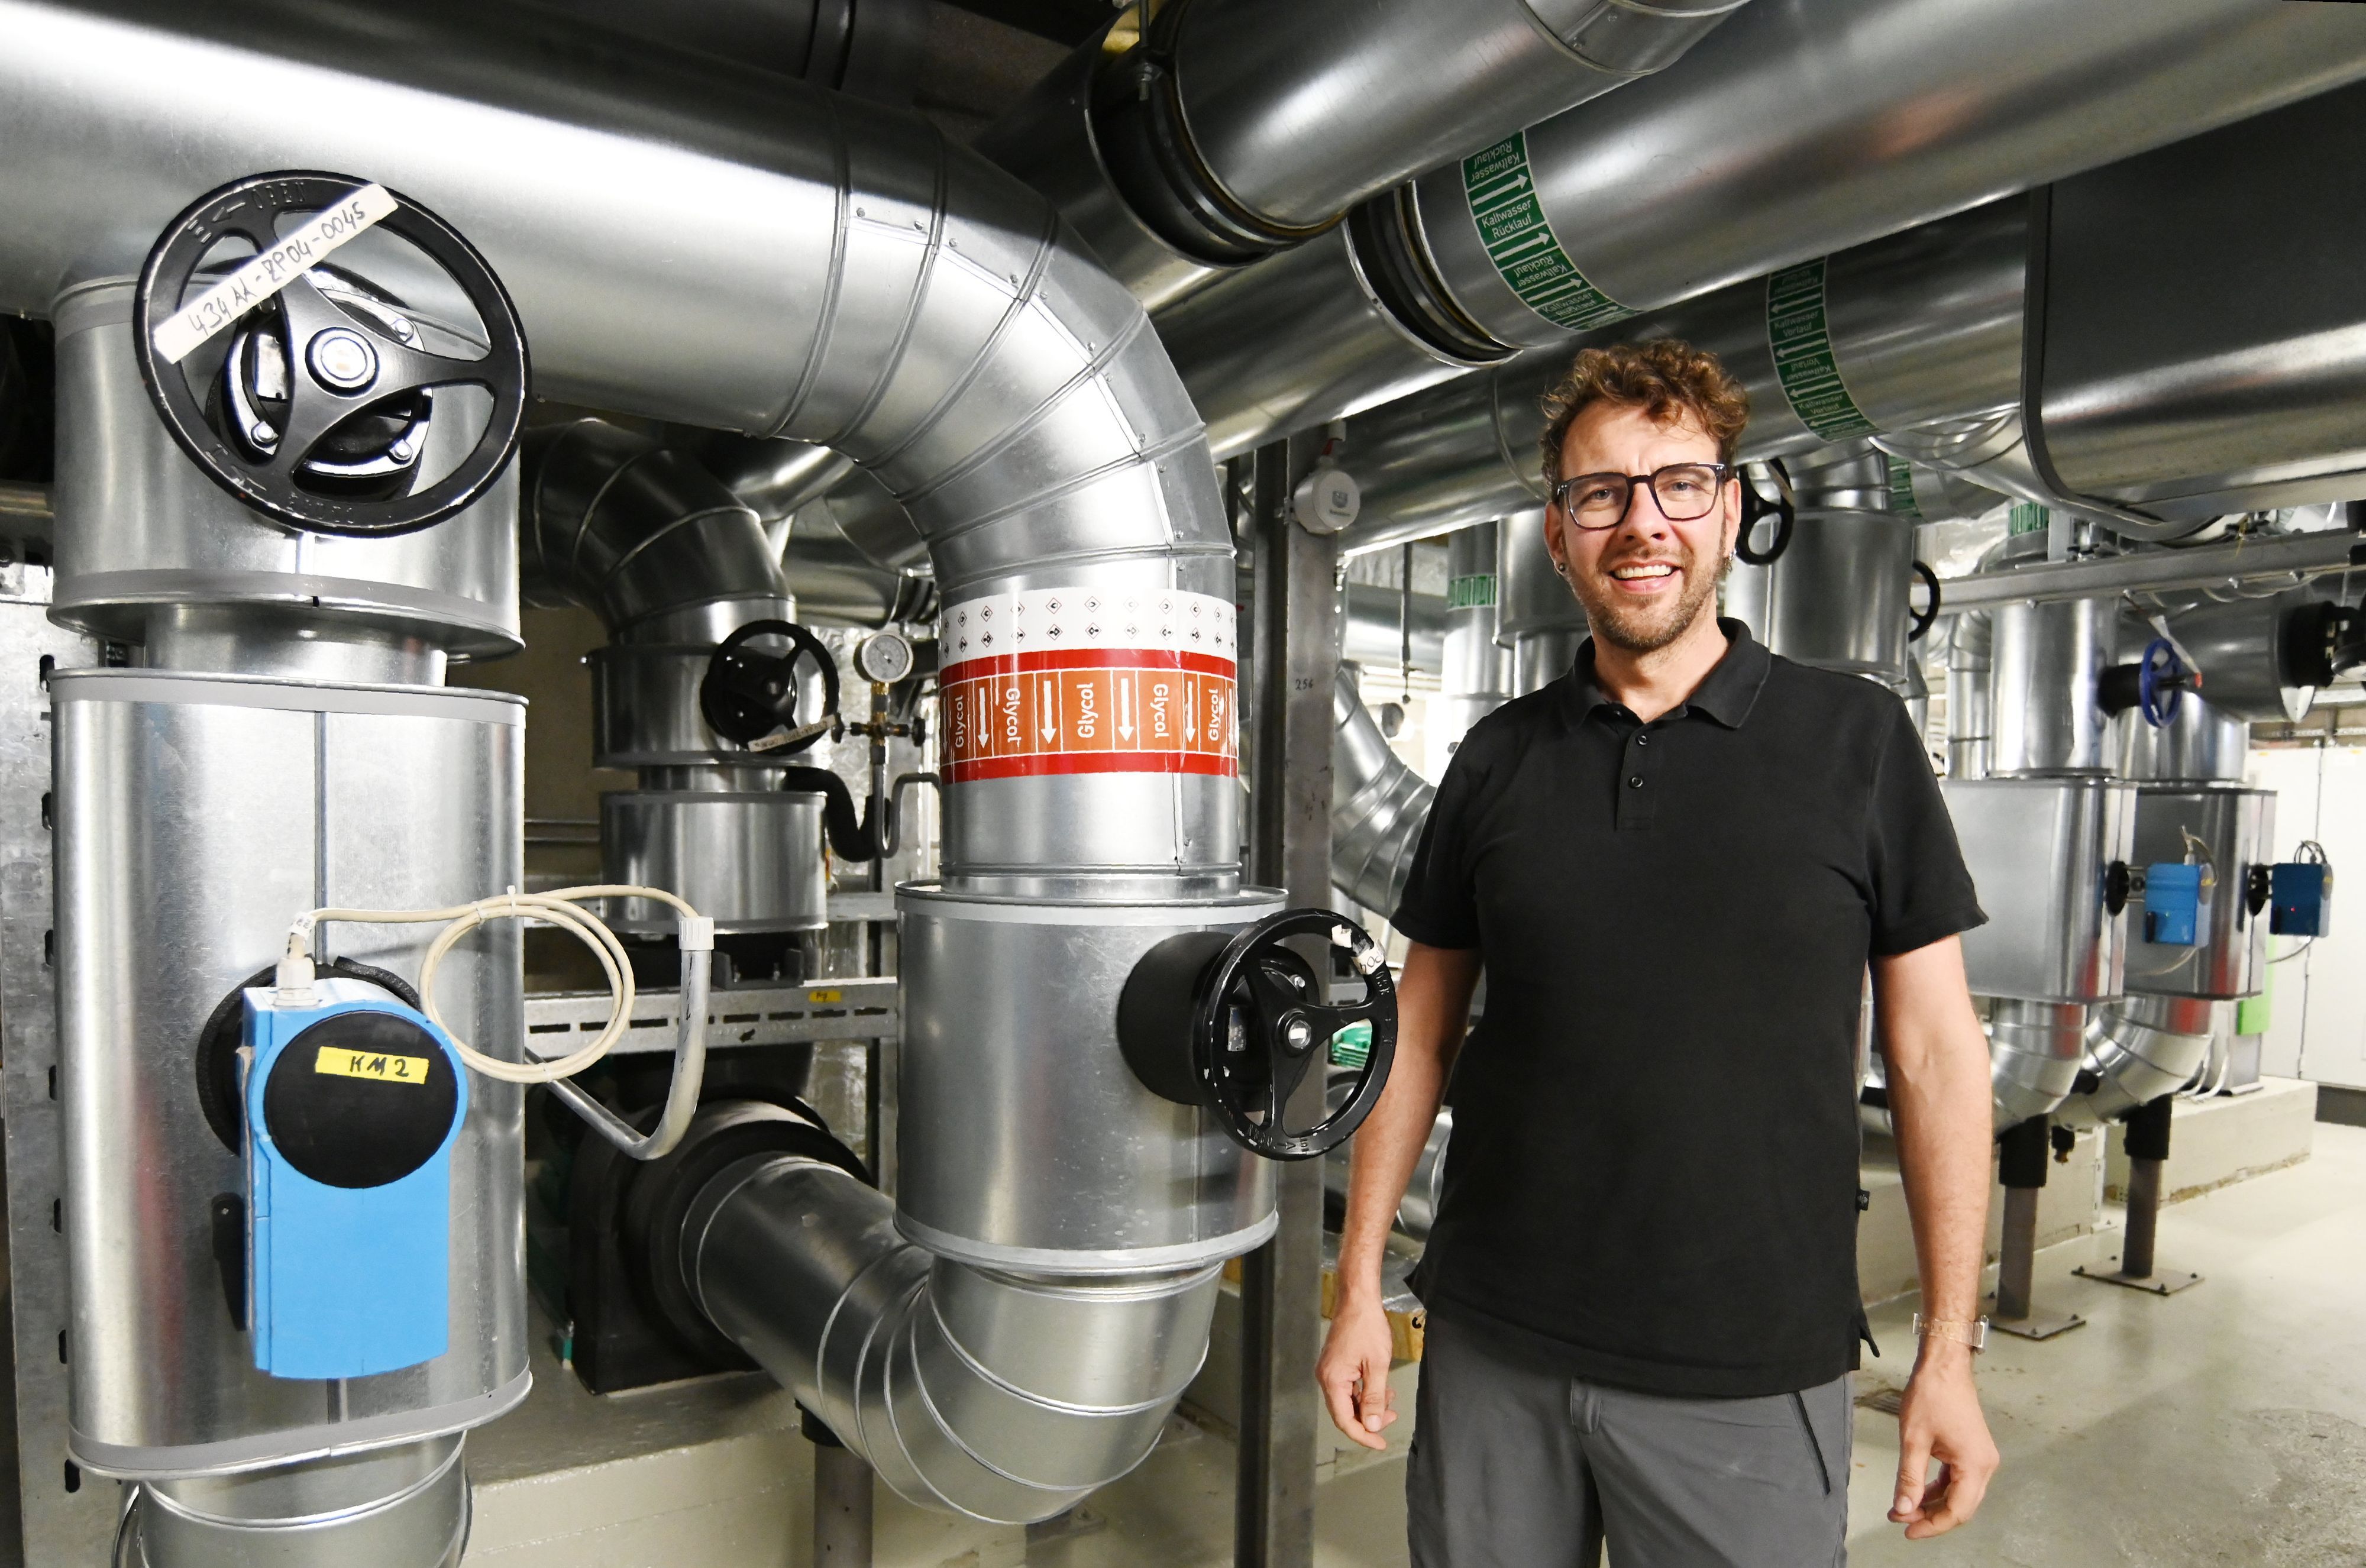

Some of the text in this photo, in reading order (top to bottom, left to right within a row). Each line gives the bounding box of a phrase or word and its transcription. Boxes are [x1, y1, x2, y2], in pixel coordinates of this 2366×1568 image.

[1471, 152, 1520, 182] Kaltwasser
[1475, 141, 1513, 169] Rücklauf
[1482, 199, 1531, 228] Kaltwasser
[1492, 214, 1532, 239] Rücklauf
[1514, 255, 1554, 277] Rücklauf
[1517, 264, 1567, 292] Kaltwasser
[955, 694, 964, 748] Glycol
[1076, 682, 1098, 739] Glycol
[1152, 683, 1169, 739] Glycol
[1208, 688, 1223, 742] Glycol
